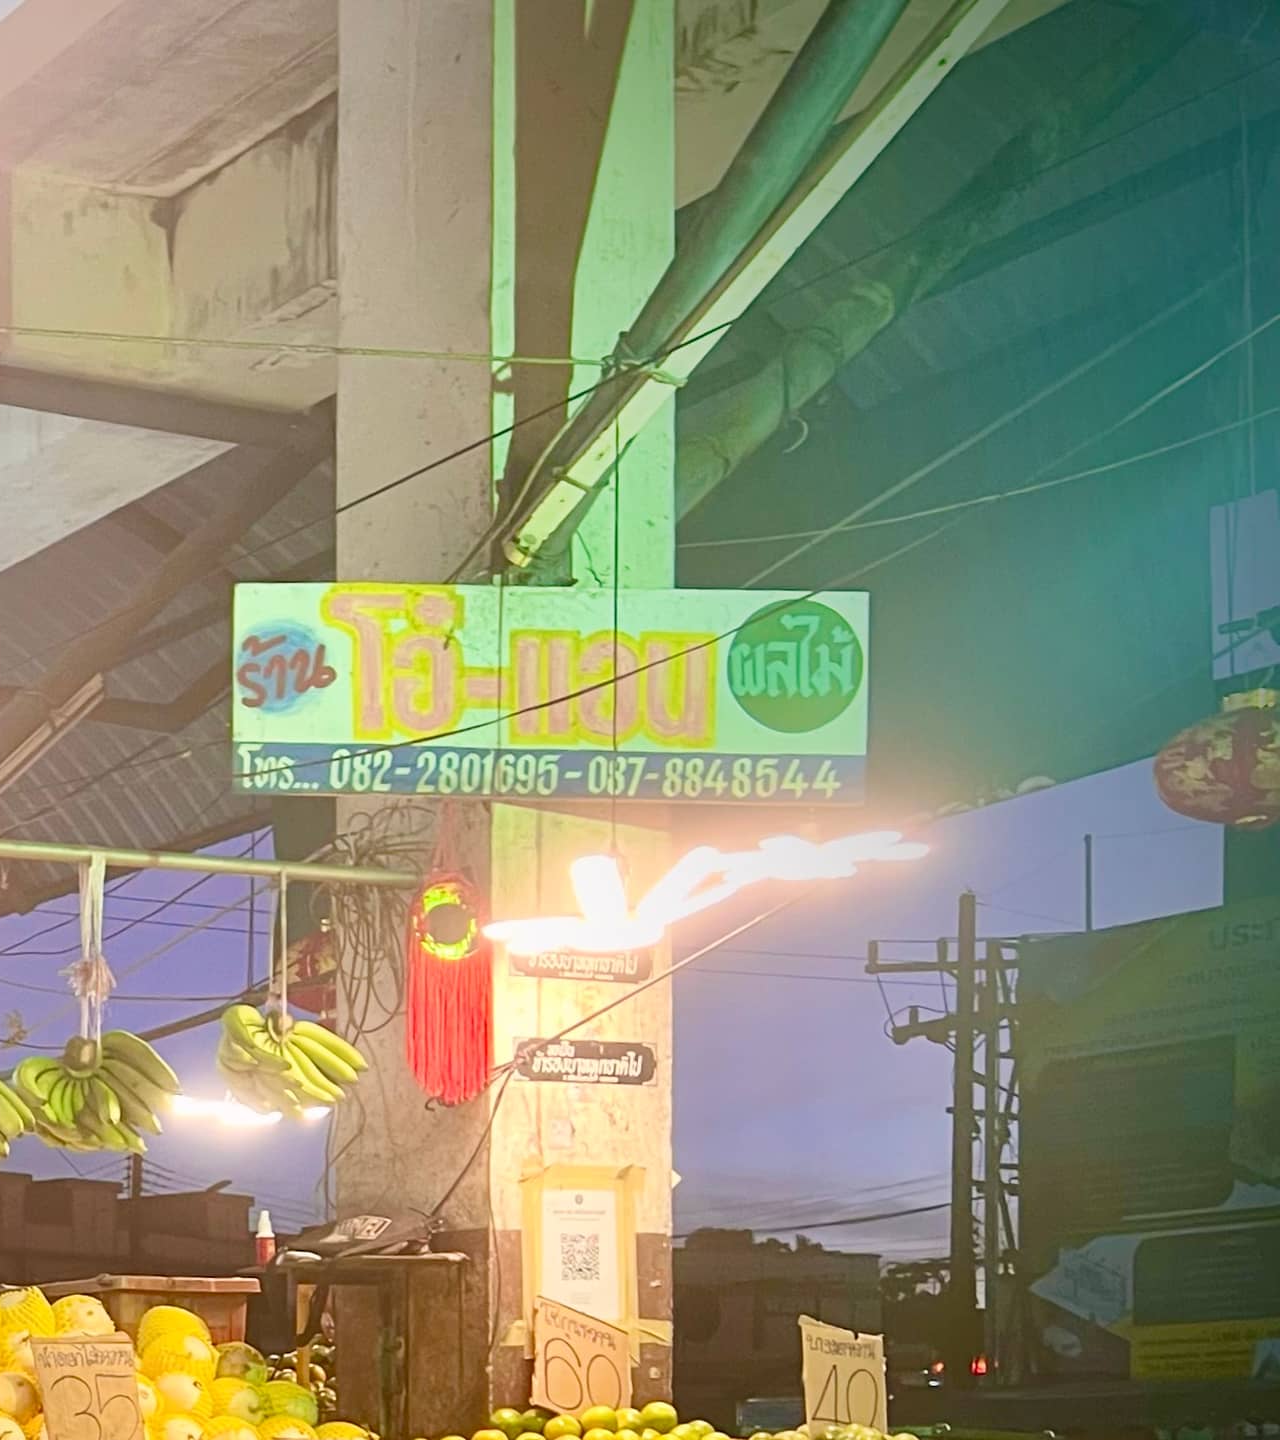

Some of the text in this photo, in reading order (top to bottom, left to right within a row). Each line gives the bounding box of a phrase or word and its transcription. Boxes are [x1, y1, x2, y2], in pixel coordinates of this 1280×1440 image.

[236, 634, 337, 710] ร้าน
[730, 614, 857, 699] ผลไม้
[543, 1337, 622, 1411] 60
[810, 1364, 879, 1428] 40
